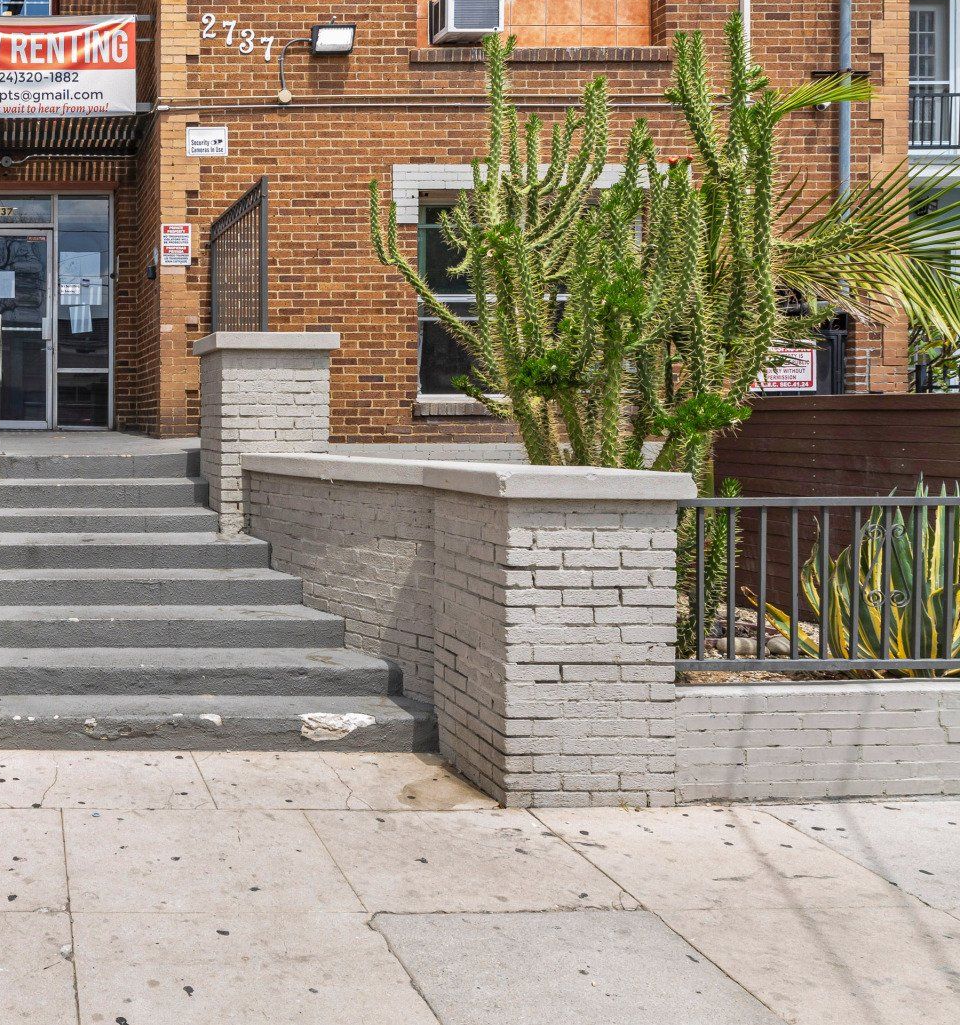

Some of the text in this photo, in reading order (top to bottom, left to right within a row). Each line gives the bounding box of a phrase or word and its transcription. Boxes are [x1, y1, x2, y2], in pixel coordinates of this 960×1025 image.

[11, 29, 128, 64] RENTING
[201, 13, 275, 62] 2737
[3, 105, 25, 113] wait
[27, 105, 36, 113] to
[38, 103, 60, 113] hear
[60, 103, 86, 115] from
[86, 103, 109, 115] you!
